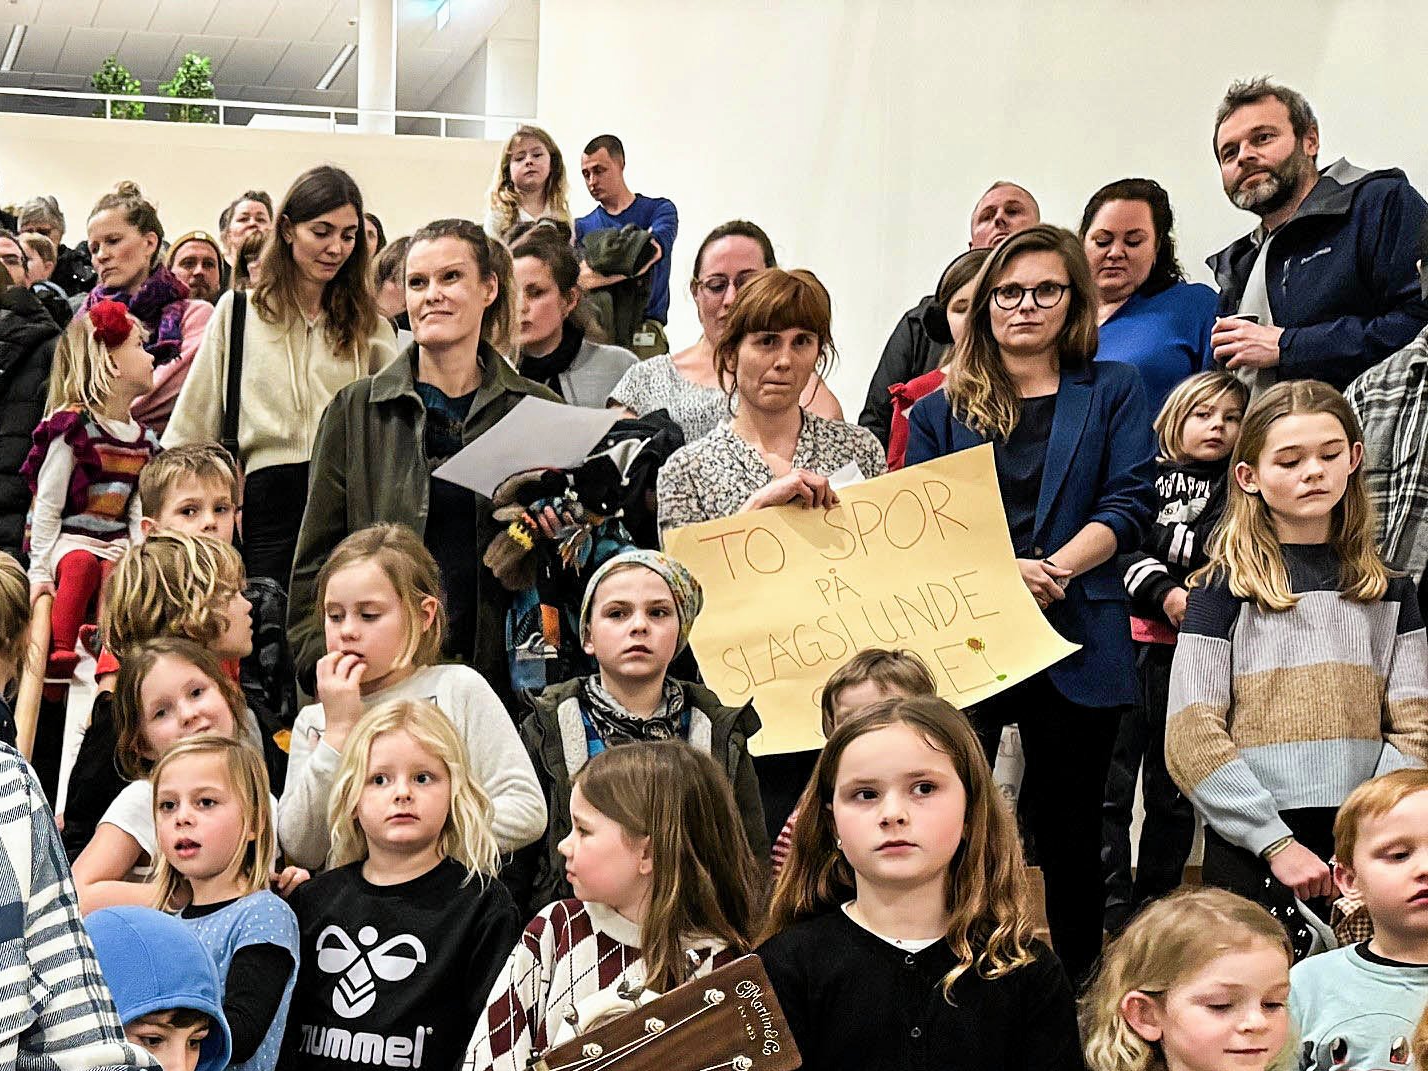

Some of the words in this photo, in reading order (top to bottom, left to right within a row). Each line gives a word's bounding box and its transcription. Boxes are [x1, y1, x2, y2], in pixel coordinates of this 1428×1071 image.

[699, 527, 786, 580] TO
[819, 480, 969, 561] SPOR
[721, 570, 1000, 695] SLAGSLUNDE
[815, 568, 861, 606] PÅ
